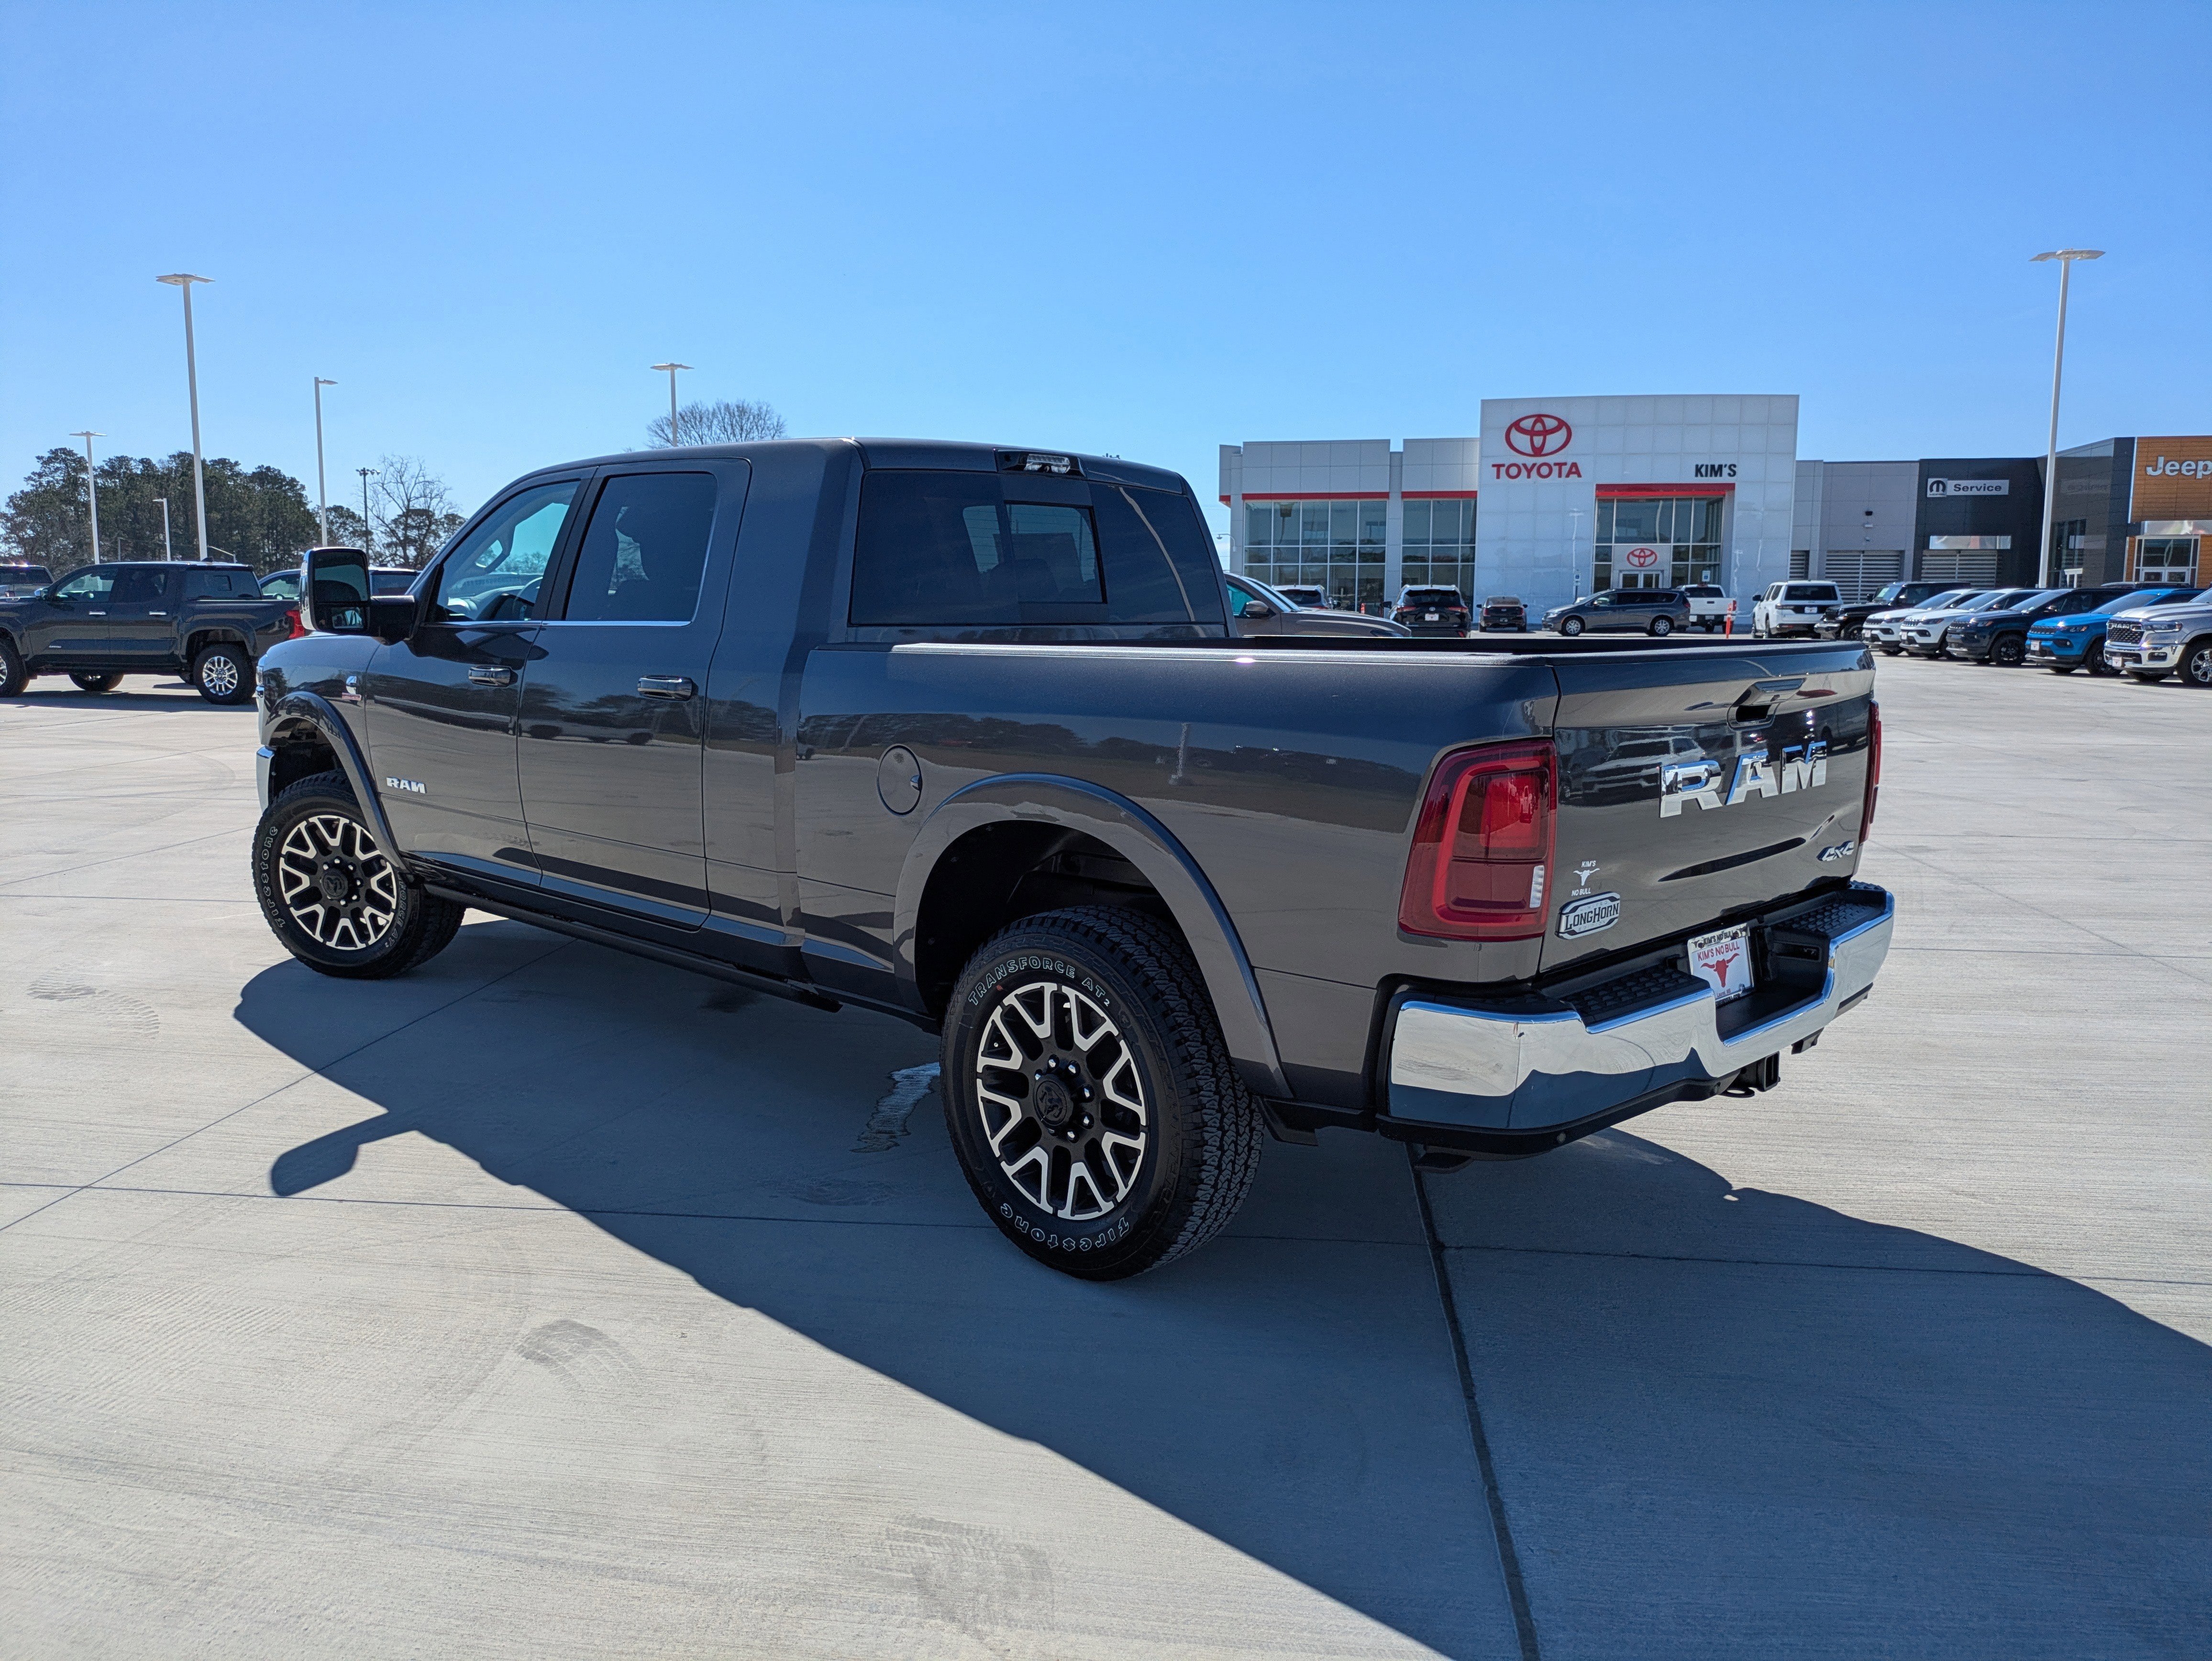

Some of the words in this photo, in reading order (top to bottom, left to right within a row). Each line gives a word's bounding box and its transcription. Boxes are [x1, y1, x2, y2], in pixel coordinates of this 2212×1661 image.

[1492, 462, 1582, 479] TOYOTA
[1694, 464, 1736, 477] KIM'S
[2146, 456, 2212, 479] Jeep
[1953, 484, 2002, 492] Service
[386, 777, 427, 794] RAM
[1659, 741, 1827, 818] RAM
[1697, 948, 1714, 962] KIM'S
[1715, 945, 1724, 956] NO
[1725, 941, 1739, 953] BULL
[968, 956, 1075, 1006] TRANSFORCE
[1001, 1203, 1129, 1251] Firestone
